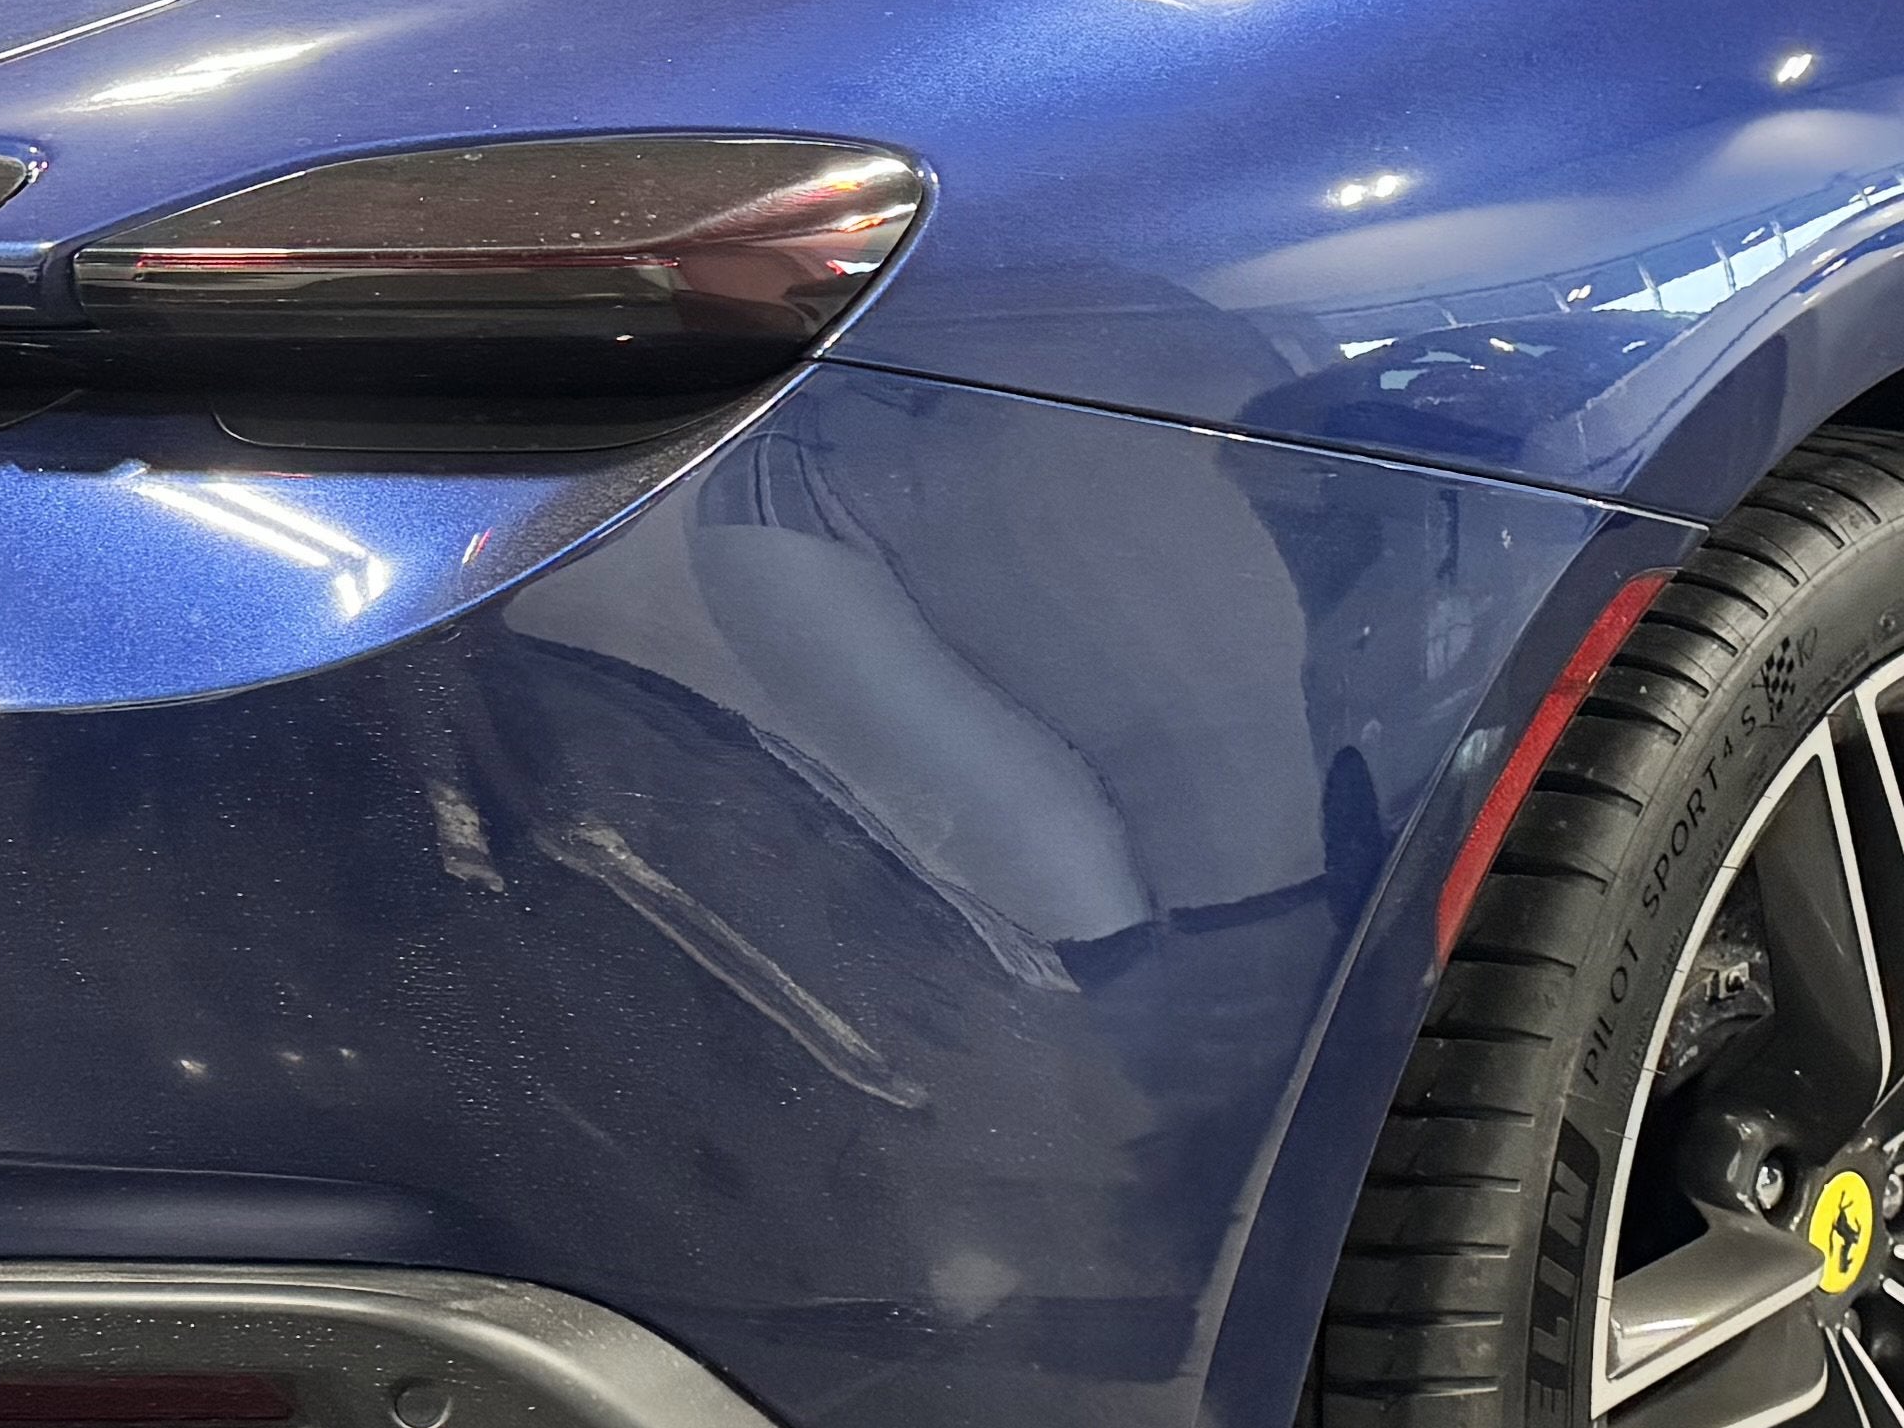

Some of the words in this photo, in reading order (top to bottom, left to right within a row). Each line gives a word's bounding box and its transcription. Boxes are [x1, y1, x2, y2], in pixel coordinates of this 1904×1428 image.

[1582, 930, 1640, 1086] PILOT
[1641, 761, 1720, 919] SPORT
[1722, 735, 1735, 759] 4
[1740, 703, 1757, 738] S
